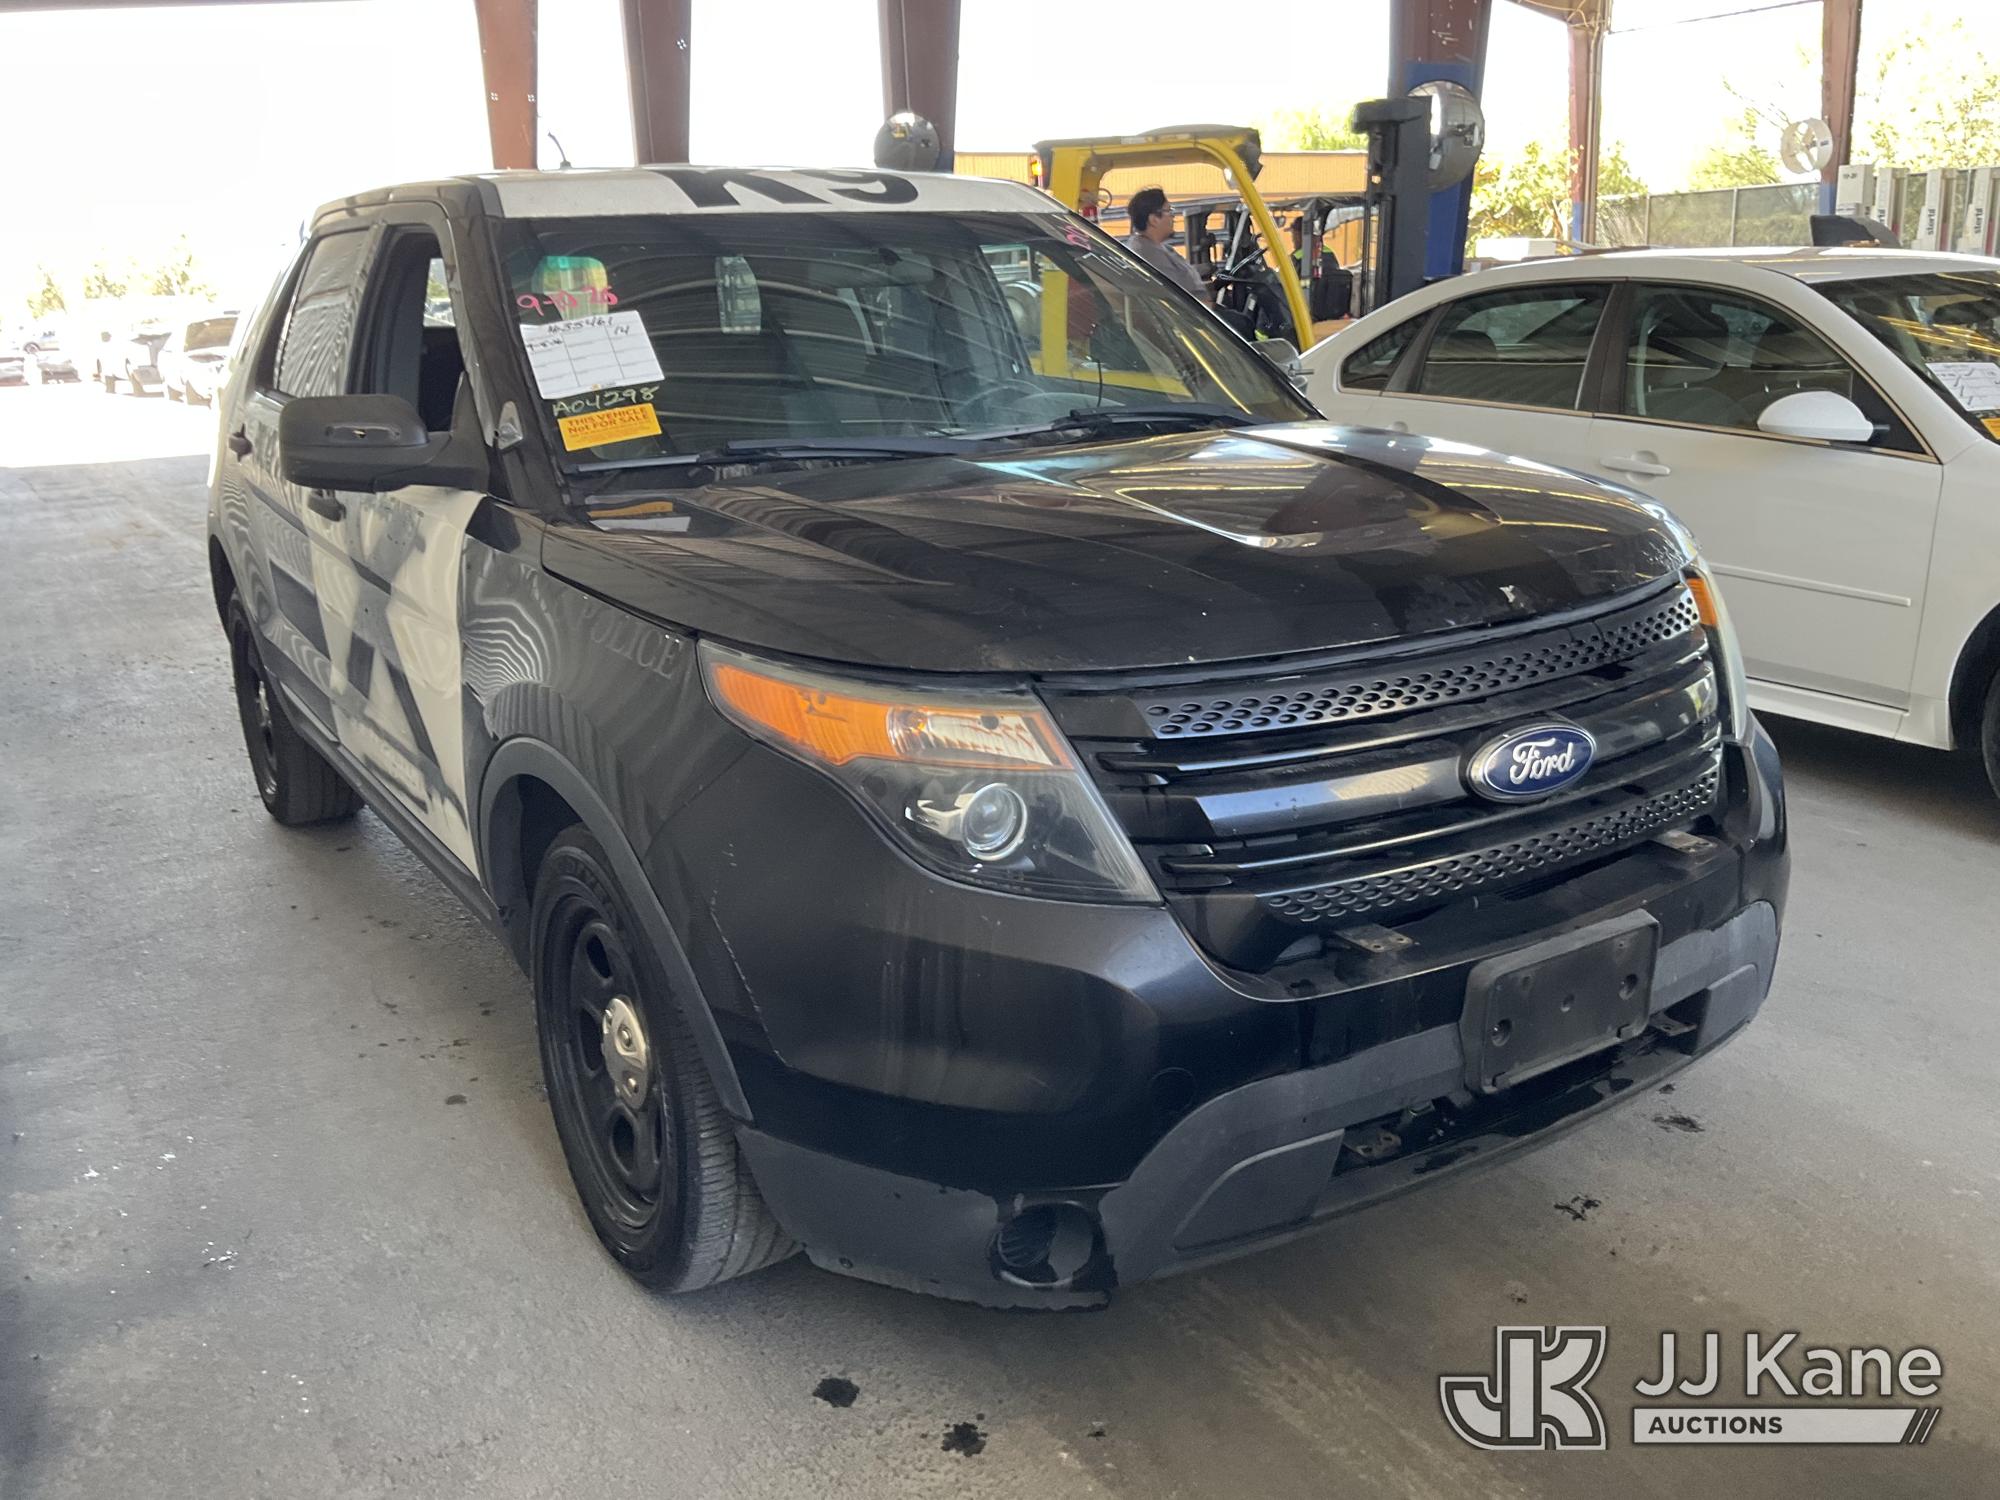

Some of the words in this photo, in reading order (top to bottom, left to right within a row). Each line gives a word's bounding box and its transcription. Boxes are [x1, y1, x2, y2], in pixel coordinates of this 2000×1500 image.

[552, 385, 660, 417] A04298
[567, 415, 590, 427] THIS
[594, 406, 648, 422] VEHICLE
[590, 418, 617, 431] FOR
[619, 411, 650, 426] SALE
[576, 597, 684, 680] POLICE
[1509, 737, 1576, 785] Ford
